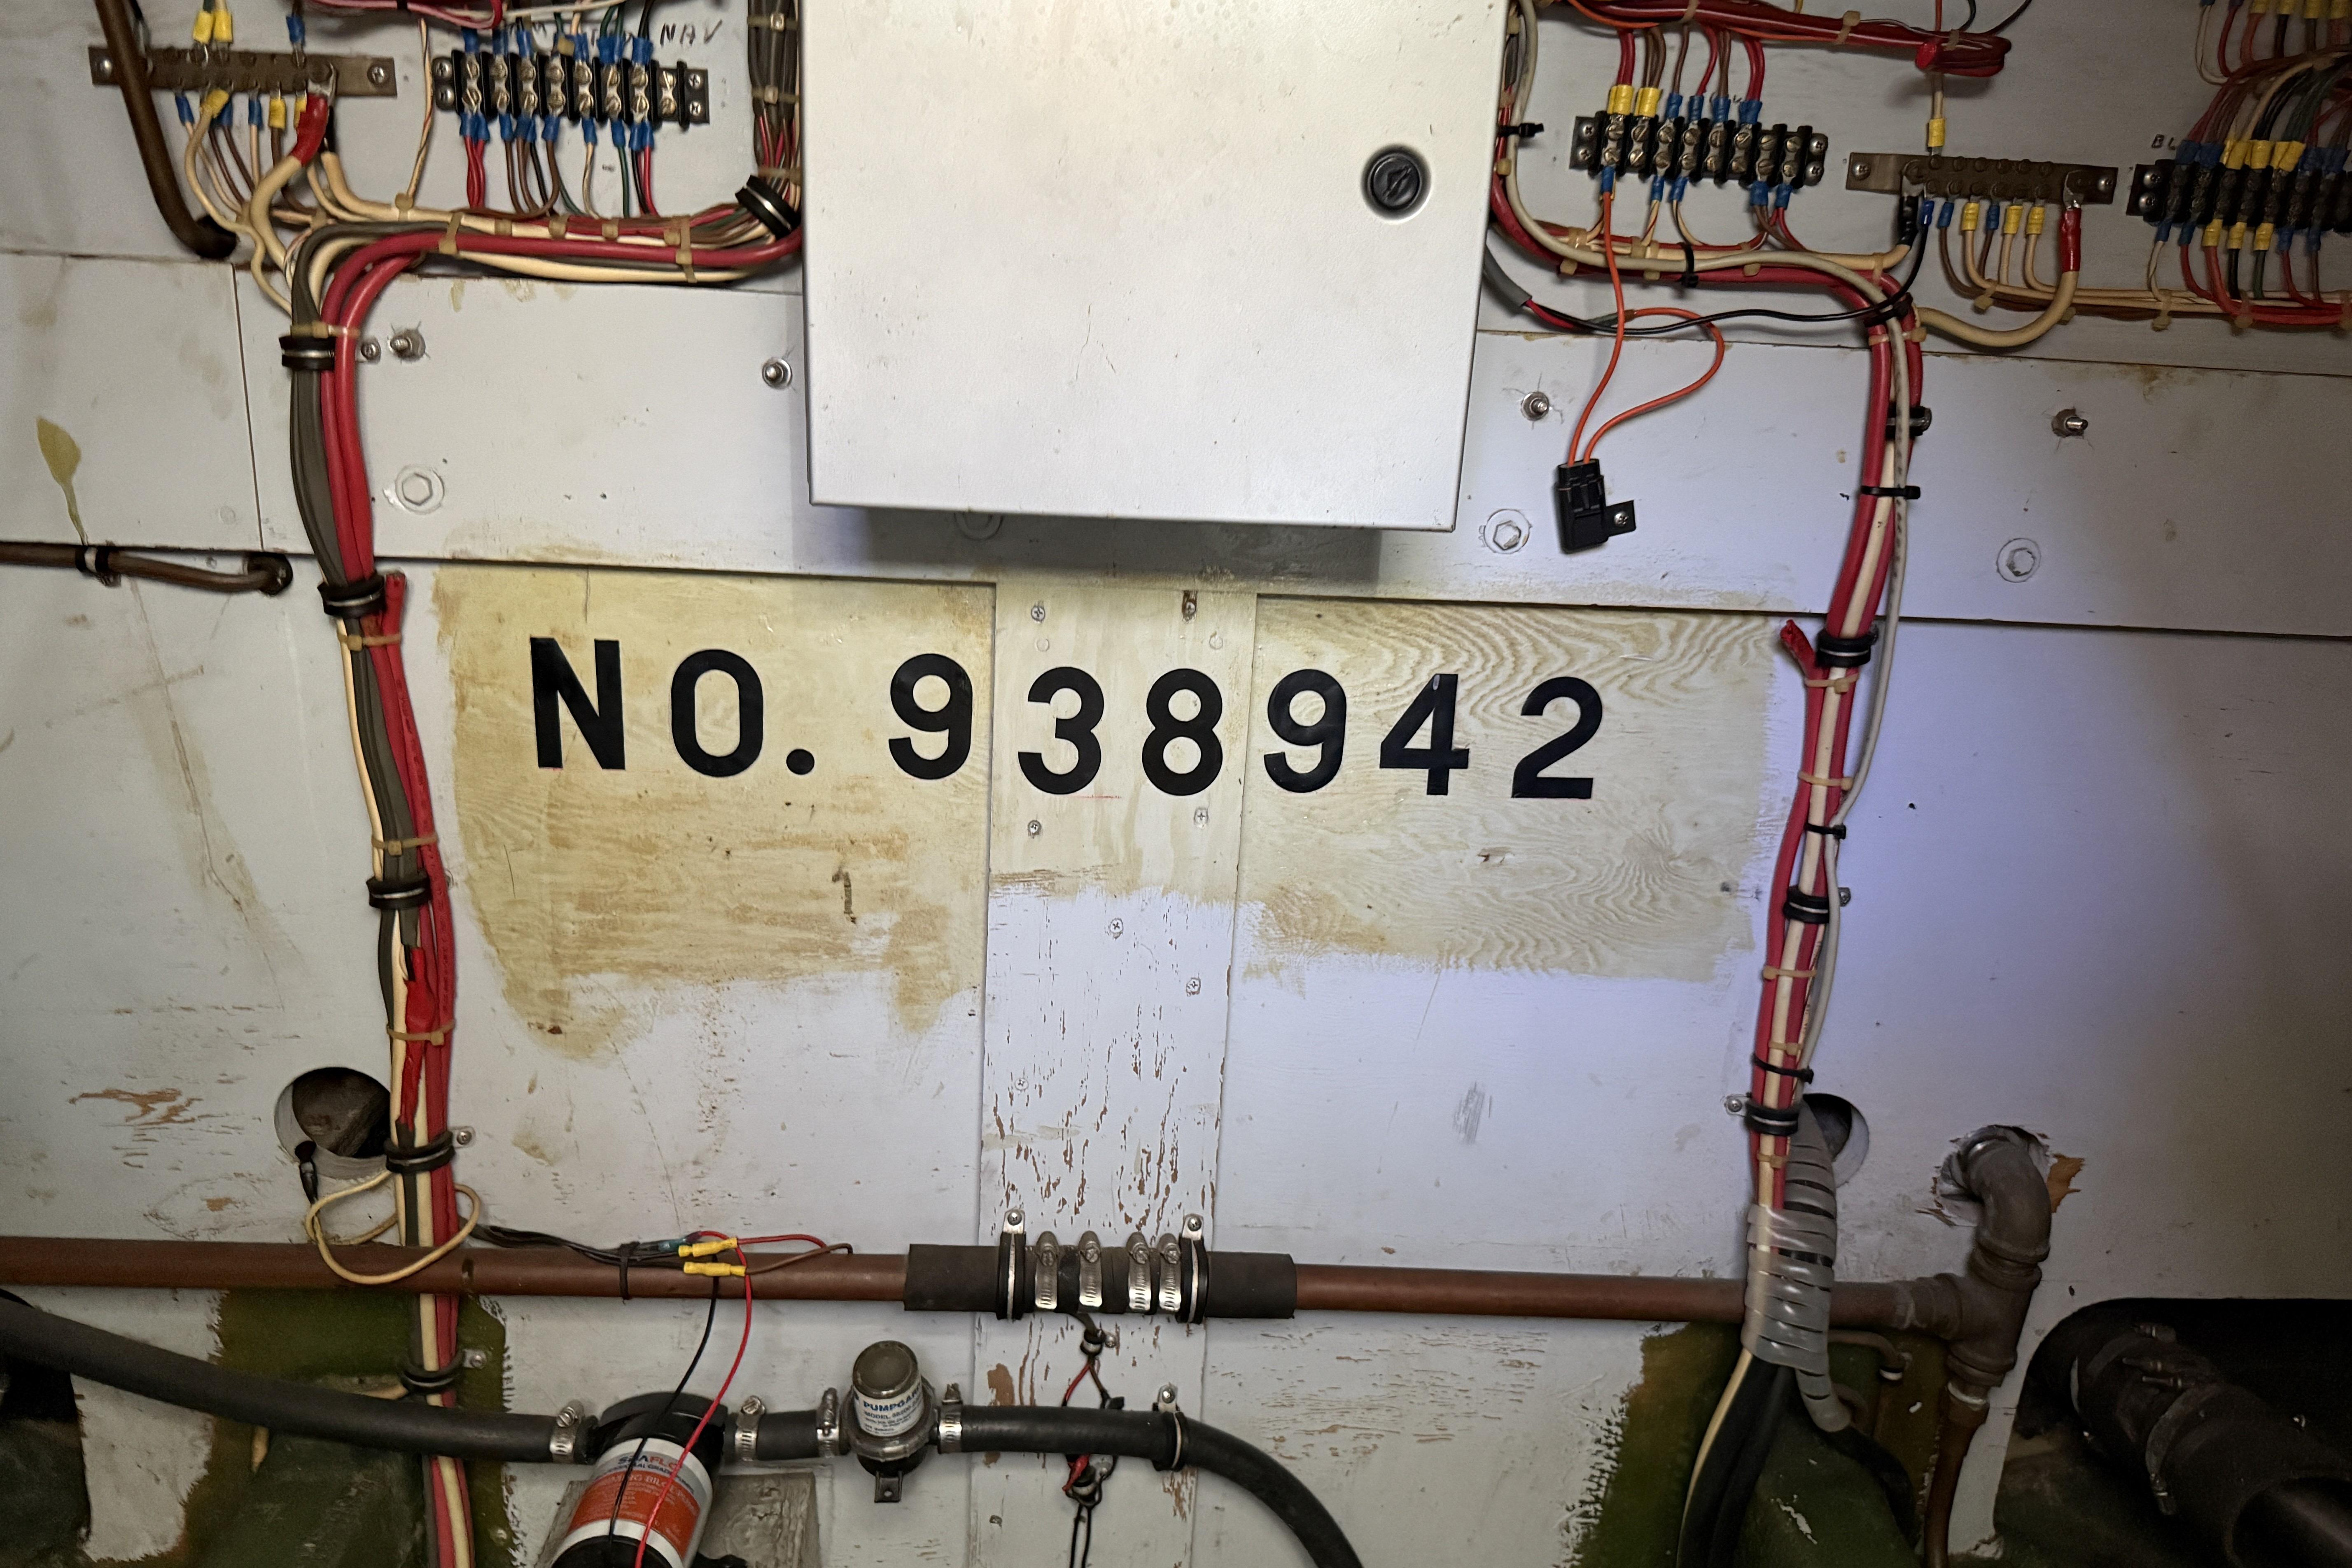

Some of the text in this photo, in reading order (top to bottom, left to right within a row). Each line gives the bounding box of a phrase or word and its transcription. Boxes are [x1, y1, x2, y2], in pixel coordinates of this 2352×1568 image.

[660, 19, 723, 48] NAV
[530, 636, 815, 778] NO.
[888, 653, 1603, 799] 938942
